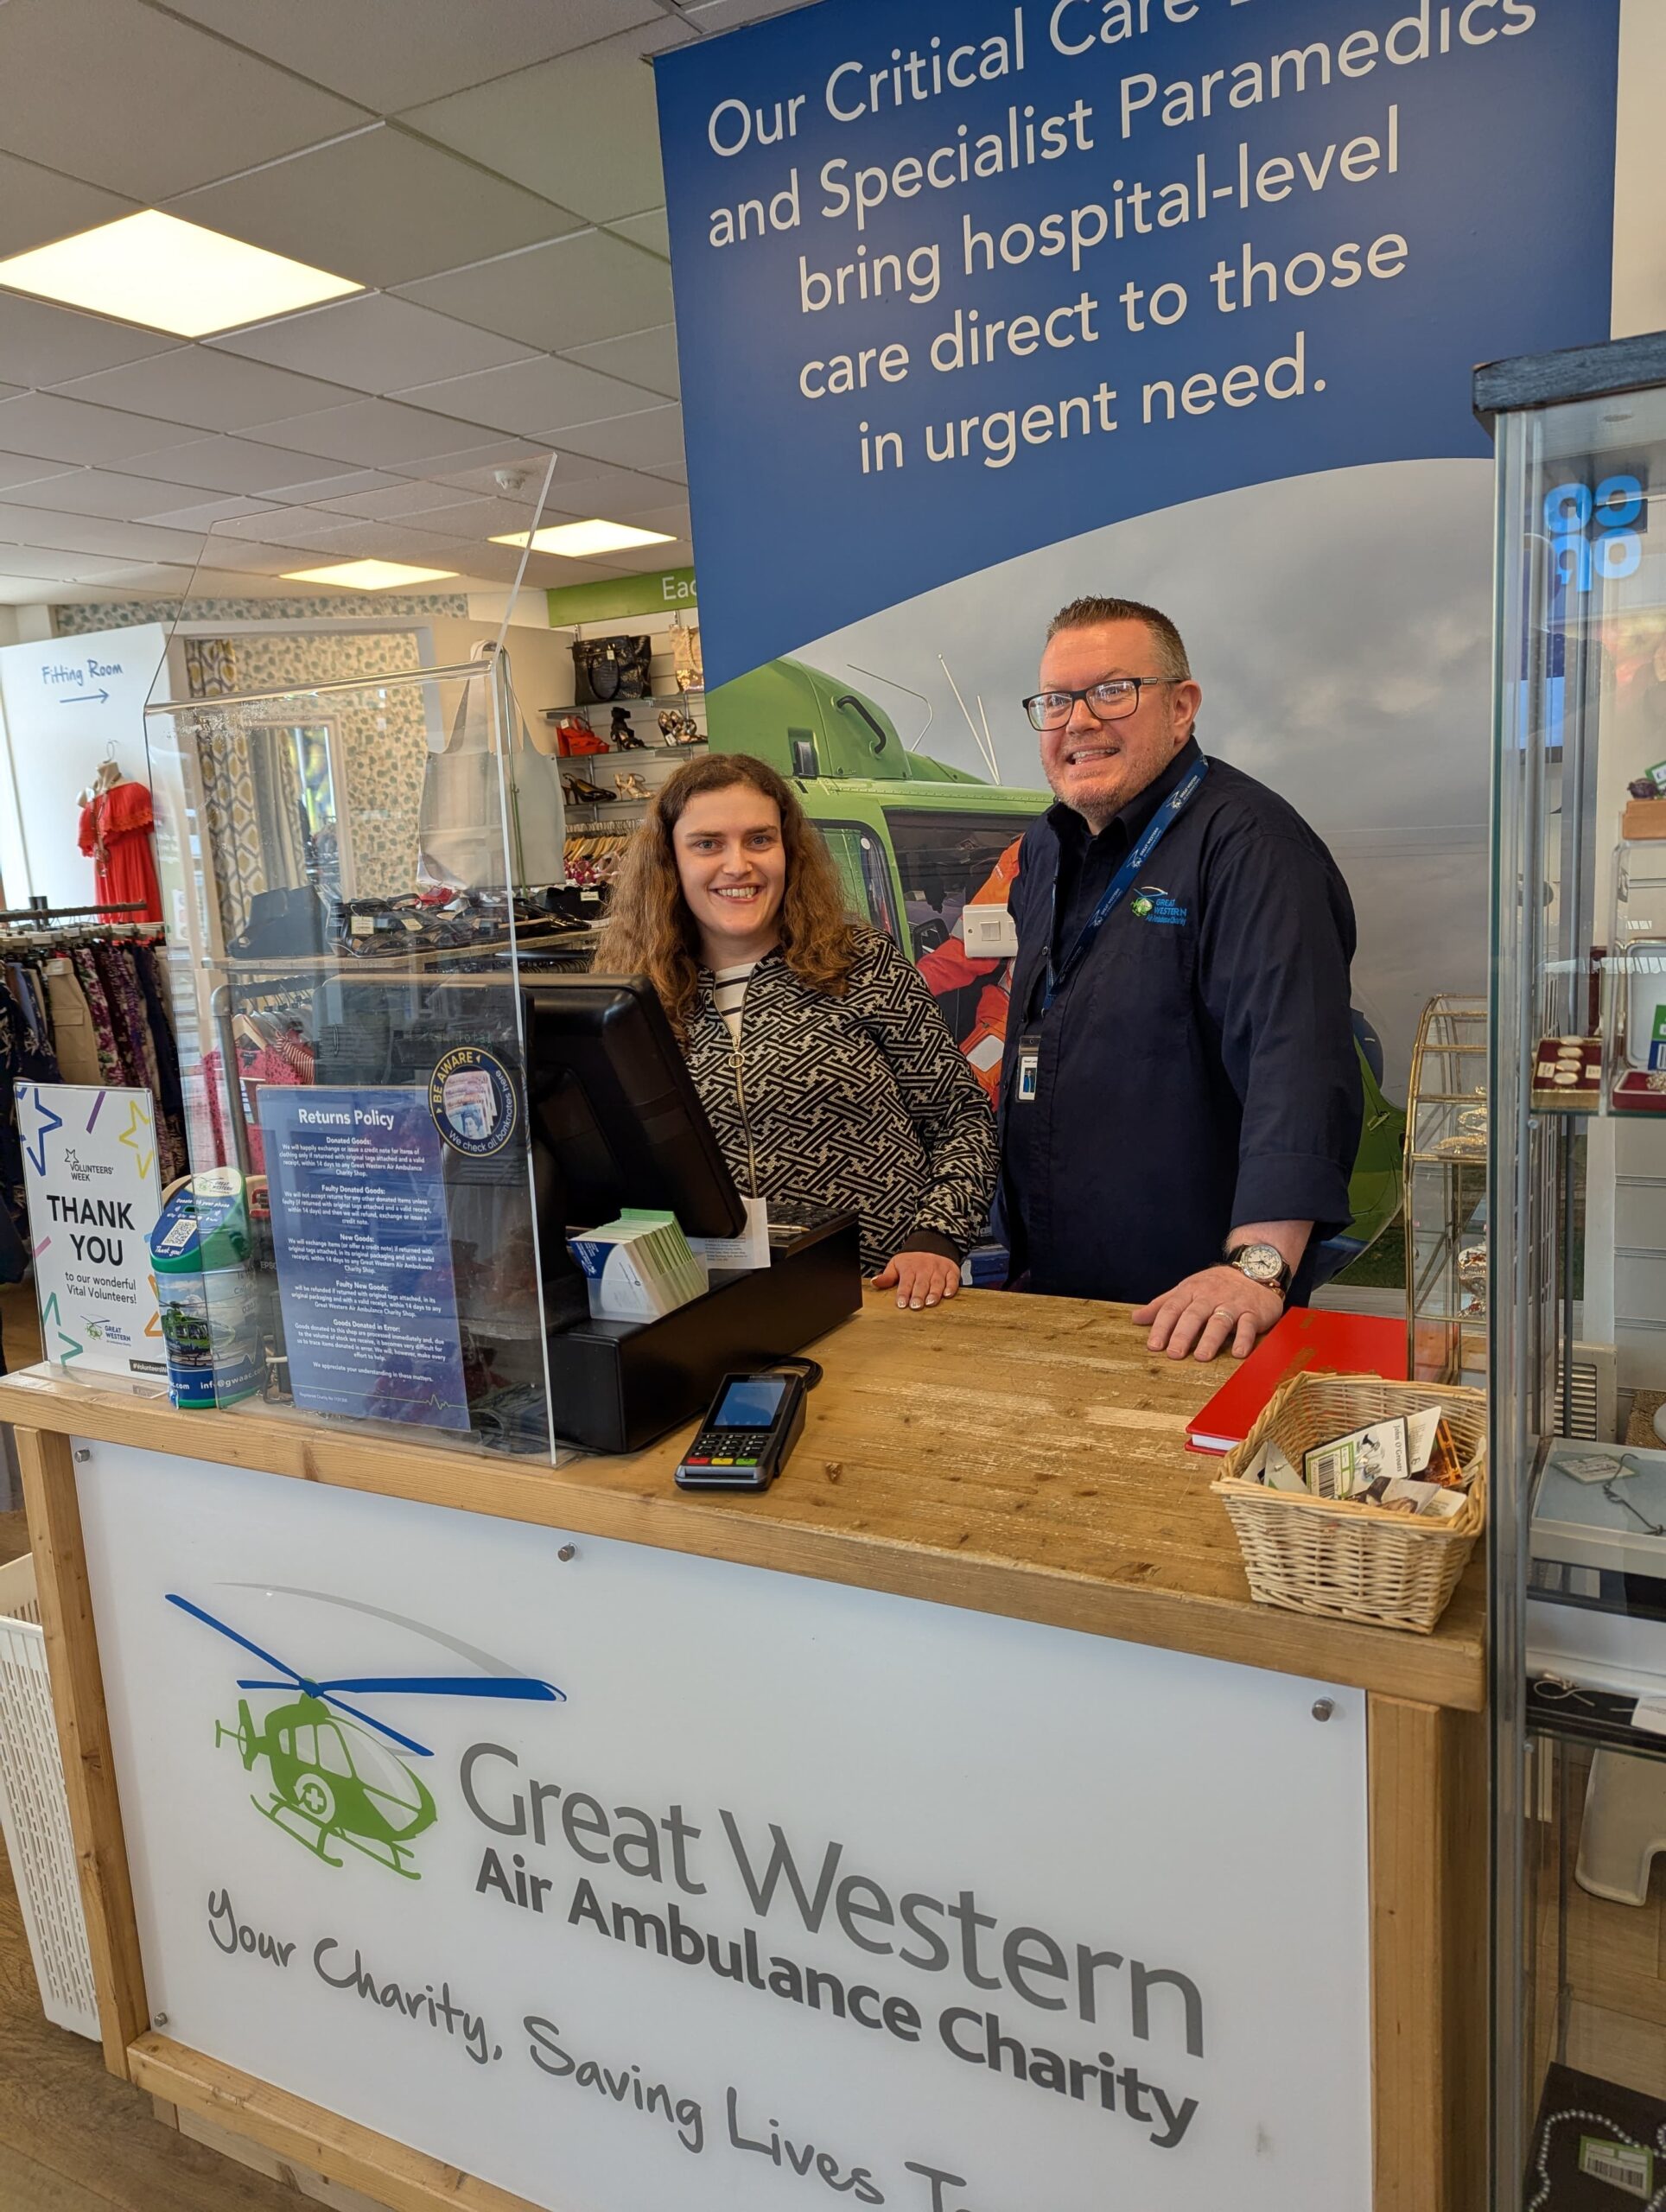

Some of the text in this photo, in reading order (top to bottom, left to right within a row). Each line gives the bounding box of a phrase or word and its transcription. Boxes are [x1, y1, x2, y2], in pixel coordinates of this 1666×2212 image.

[709, 94, 806, 157] Our
[825, 7, 1025, 123] Critical
[709, 0, 1536, 248] and Specialist Paramedics
[798, 103, 1399, 315] bring hospital-level
[798, 232, 1409, 399] care direct to those
[859, 330, 1327, 475] in urgent need.
[41, 658, 124, 686] Fitting Room
[1153, 906, 1188, 918] WESTERN
[1155, 898, 1176, 907] GREAT
[433, 1051, 474, 1103] BE AWARE
[298, 1109, 396, 1130] Returns Policy
[448, 1070, 513, 1153] We check all banknotes here
[69, 1162, 114, 1175] VOLUNTEERS'
[71, 1172, 91, 1182] WEEK
[321, 1185, 339, 1193] Faulty
[47, 1194, 136, 1231] THANK
[70, 1233, 124, 1267] YOU
[65, 1271, 137, 1291] to our wonderful
[67, 1282, 137, 1305] Vital Volunteers!
[335, 1280, 353, 1289] Faulty
[367, 1282, 389, 1291] Goods:
[104, 1325, 123, 1334] GREAT
[105, 1332, 131, 1343] WESTERN
[352, 1320, 376, 1329] Donated
[1391, 1424, 1403, 1472] John O'Groats
[460, 1742, 1205, 2059] Great Western
[475, 1847, 1200, 2150] Air Ambulance Charity
[207, 1888, 297, 1968] Your
[313, 1937, 505, 2064] Charity,
[523, 2015, 705, 2154] Saving
[726, 2086, 886, 2206] Lives
